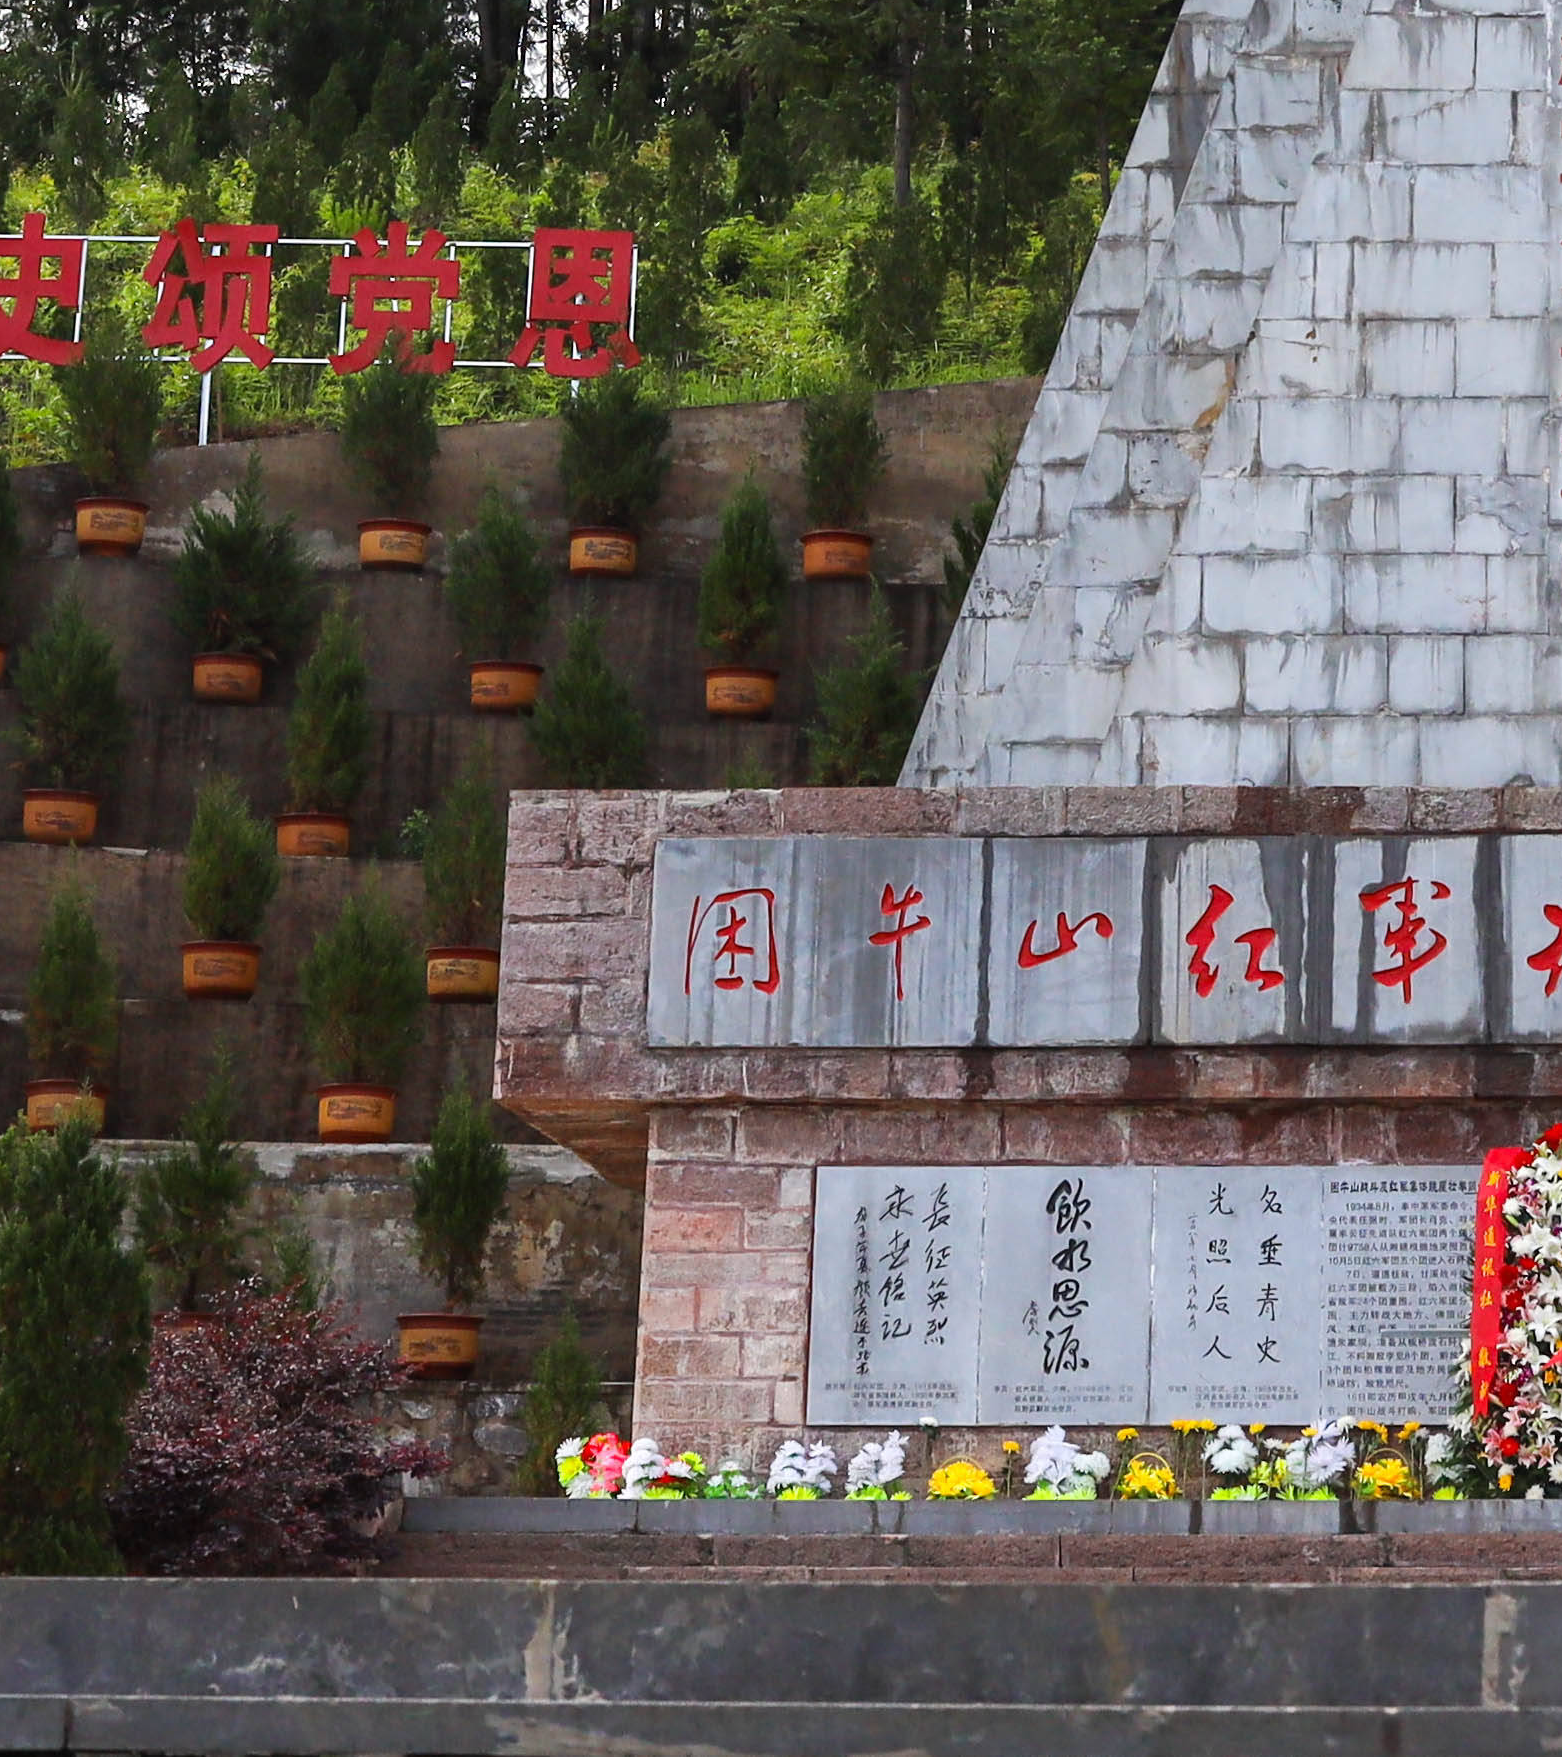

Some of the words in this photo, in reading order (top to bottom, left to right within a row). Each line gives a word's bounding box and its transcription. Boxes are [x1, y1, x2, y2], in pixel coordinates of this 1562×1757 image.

[1202, 1183, 1235, 1361] 光照后人
[1257, 1184, 1284, 1364] 名垂青史
